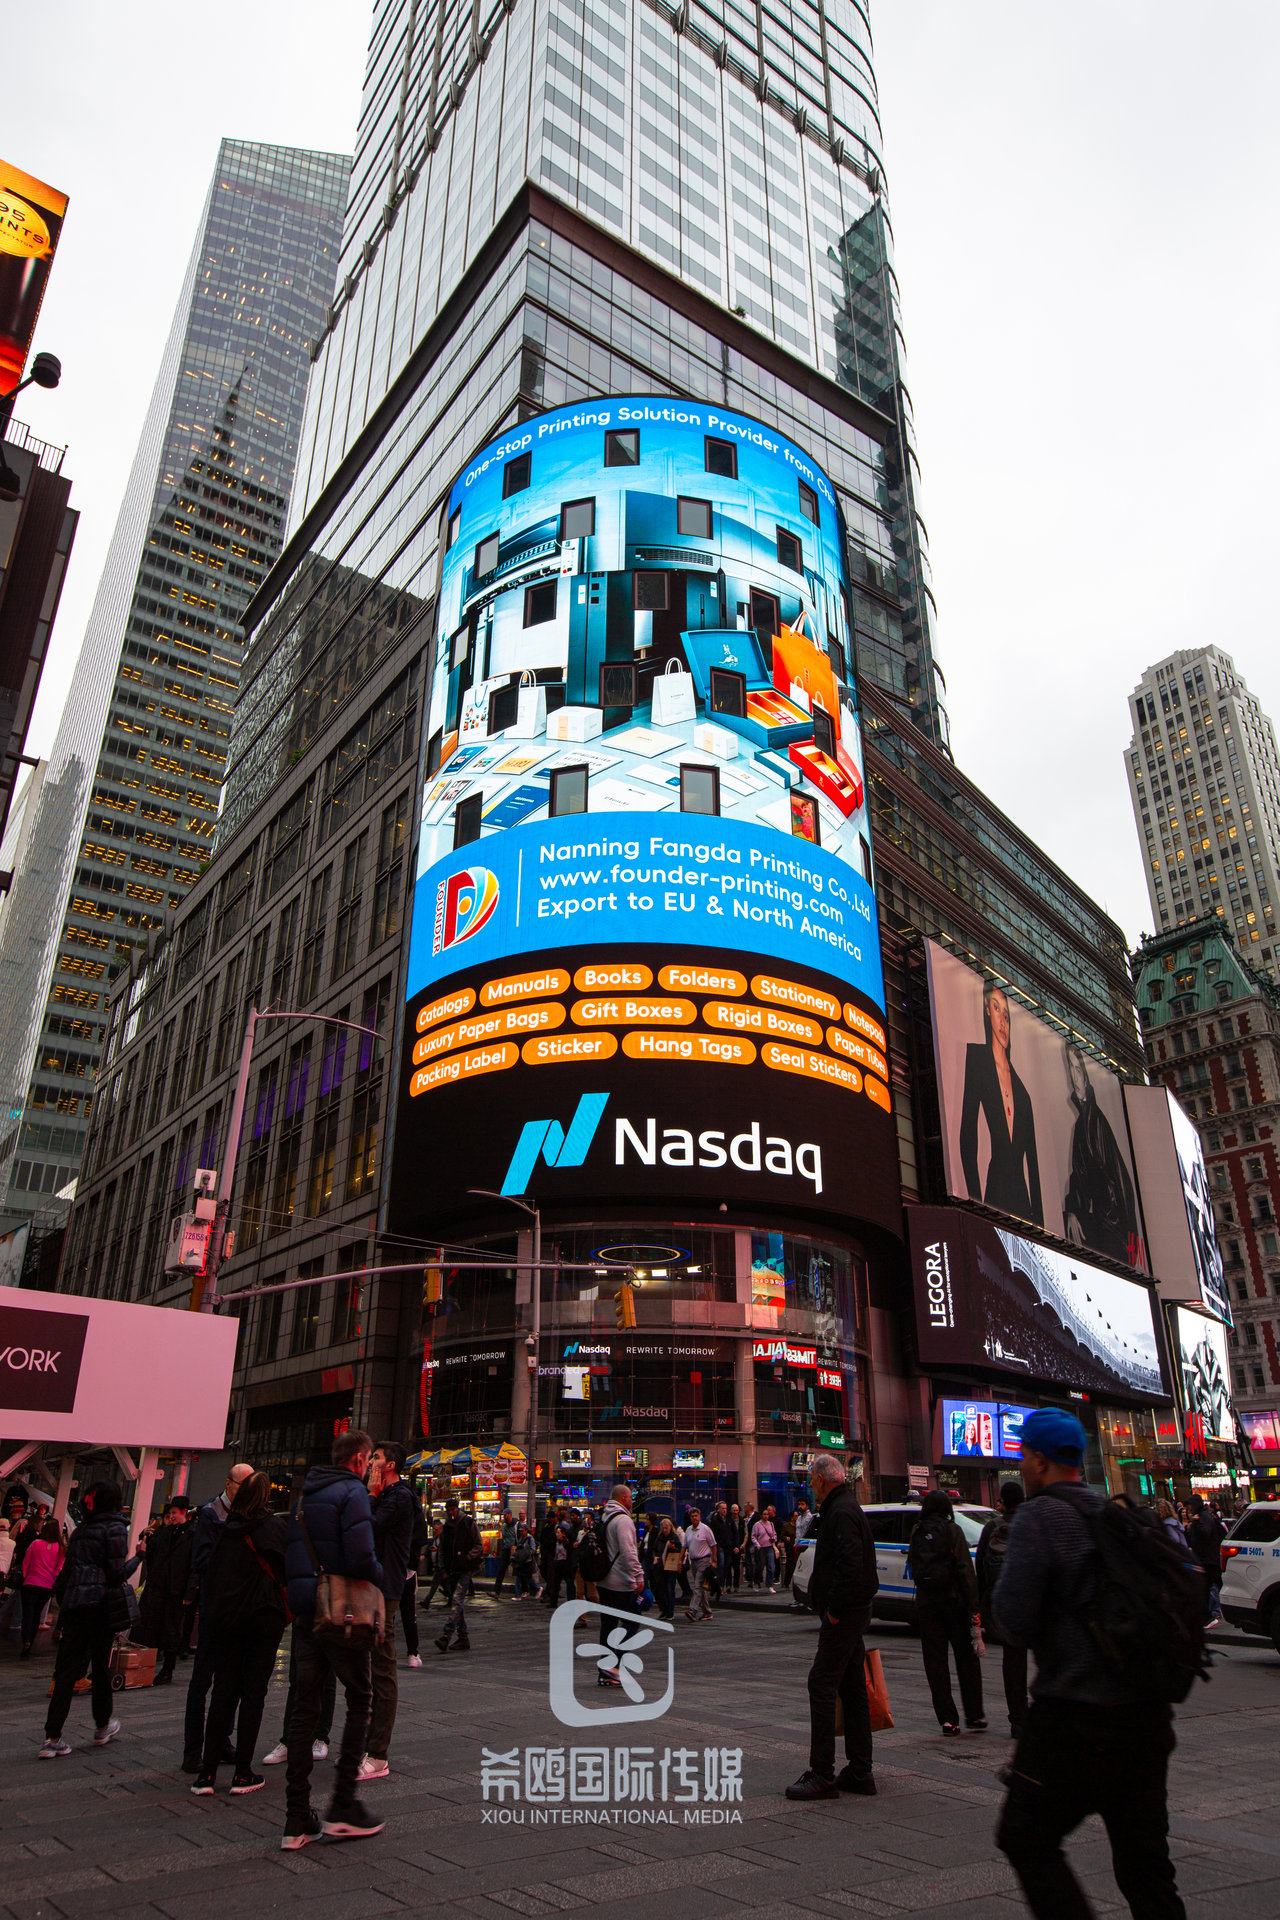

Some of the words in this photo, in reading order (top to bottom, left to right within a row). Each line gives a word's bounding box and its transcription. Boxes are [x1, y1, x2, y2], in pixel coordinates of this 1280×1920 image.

[465, 433, 532, 488] One-Stop
[539, 410, 611, 439] Printing
[618, 408, 701, 426] Solution
[708, 415, 780, 455] Provider
[784, 449, 815, 483] from
[539, 838, 639, 863] Nanning
[650, 838, 741, 863] Fangda
[750, 849, 823, 893] Printing
[828, 878, 870, 922] Co.,Ltd
[540, 864, 843, 925] www.founder-printing.com
[432, 880, 446, 957] FOUNDER
[538, 891, 617, 919] Export
[627, 891, 653, 911] to
[665, 892, 695, 912] EU
[707, 896, 724, 914] &
[733, 901, 793, 930] North
[800, 918, 862, 962] America
[420, 996, 470, 1027] Catalogs
[488, 975, 559, 1000] Manuals
[585, 970, 641, 985] Books
[670, 971, 736, 990] Folders
[761, 980, 836, 1017] Stationery
[417, 1059, 460, 1088] Packing
[465, 1048, 506, 1069] Label
[538, 1038, 602, 1057] Sticker
[640, 1037, 692, 1056] Hang
[701, 1039, 741, 1058] Tags
[770, 1048, 804, 1068] Seal
[809, 1056, 858, 1087] Stickers
[419, 1029, 454, 1057] Luxury
[459, 1019, 501, 1043] Paper
[507, 1010, 548, 1030] Bags
[582, 1004, 621, 1019] Gift
[628, 1003, 682, 1018] Boxes
[718, 1007, 762, 1030] Rigid
[768, 1013, 812, 1038] Boxes
[835, 1032, 864, 1058] Paper
[866, 1048, 886, 1074] Tubes
[615, 1118, 823, 1194] Nasdaq
[924, 1242, 947, 1327] LEGORA
[446, 1356, 467, 1365] REWRITE
[578, 1345, 611, 1355] Nasdaq
[626, 1346, 664, 1354] REWRITE
[668, 1347, 715, 1356] TOMORROW
[623, 1405, 668, 1420] Nasdaq
[1157, 1422, 1176, 1436] H&M
[1185, 1410, 1207, 1456] H&M
